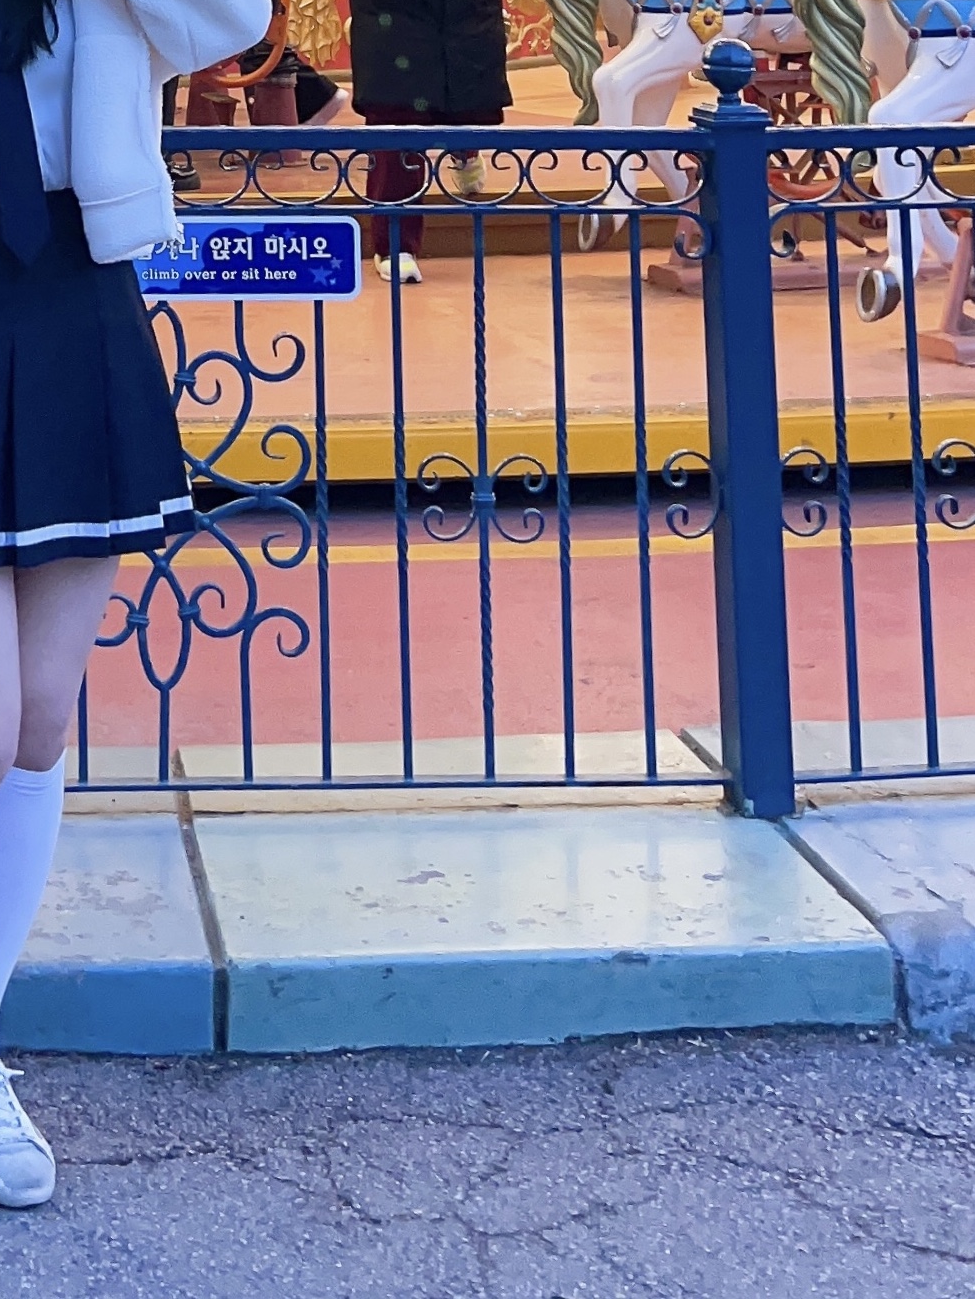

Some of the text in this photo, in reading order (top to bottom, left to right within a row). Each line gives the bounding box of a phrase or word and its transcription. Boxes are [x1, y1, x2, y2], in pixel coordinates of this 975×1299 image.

[210, 237, 252, 261] 앉지
[264, 236, 332, 261] 마시오
[142, 268, 297, 280] climb over or sit here
